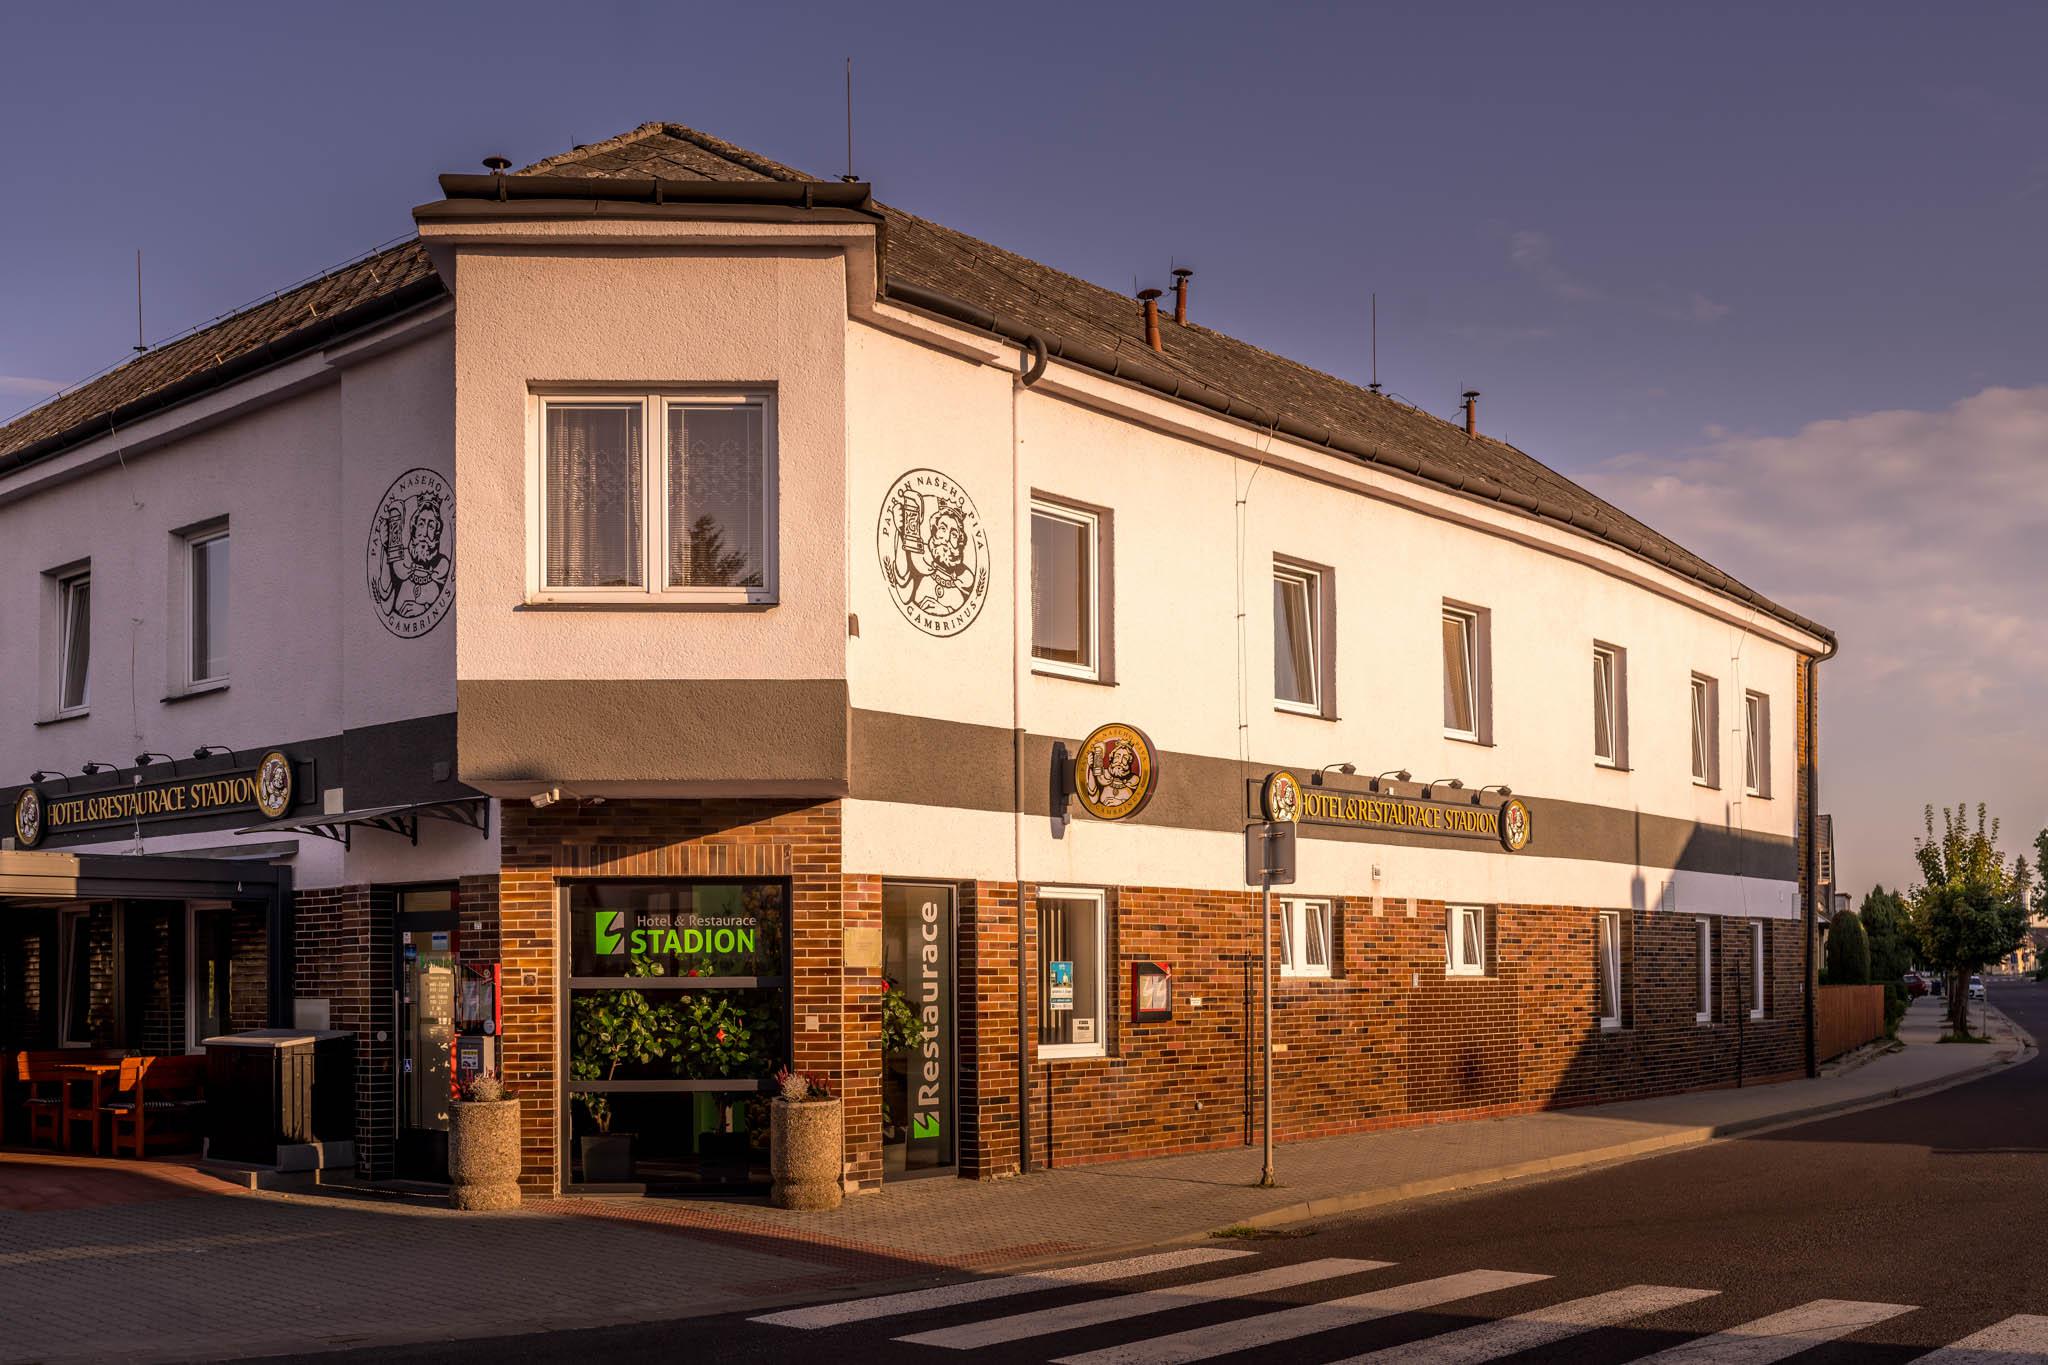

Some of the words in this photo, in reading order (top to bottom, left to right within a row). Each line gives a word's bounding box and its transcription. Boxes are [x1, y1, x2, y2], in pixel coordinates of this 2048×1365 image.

[371, 495, 396, 556] PATRON
[399, 475, 442, 492] NAŠEHO
[882, 481, 912, 537] PATRON
[917, 476, 965, 506] NAŠEHO
[967, 511, 984, 551] PIVA
[388, 589, 451, 633] GAMBRINUS
[906, 601, 977, 631] GAMBRINUS
[191, 777, 257, 809] STADION
[1444, 810, 1498, 833] STADION
[637, 915, 671, 927] Hotel
[674, 916, 685, 927] &
[689, 915, 757, 927] Restaurace
[630, 929, 755, 954] STADION
[918, 901, 940, 1106] Restaurace
